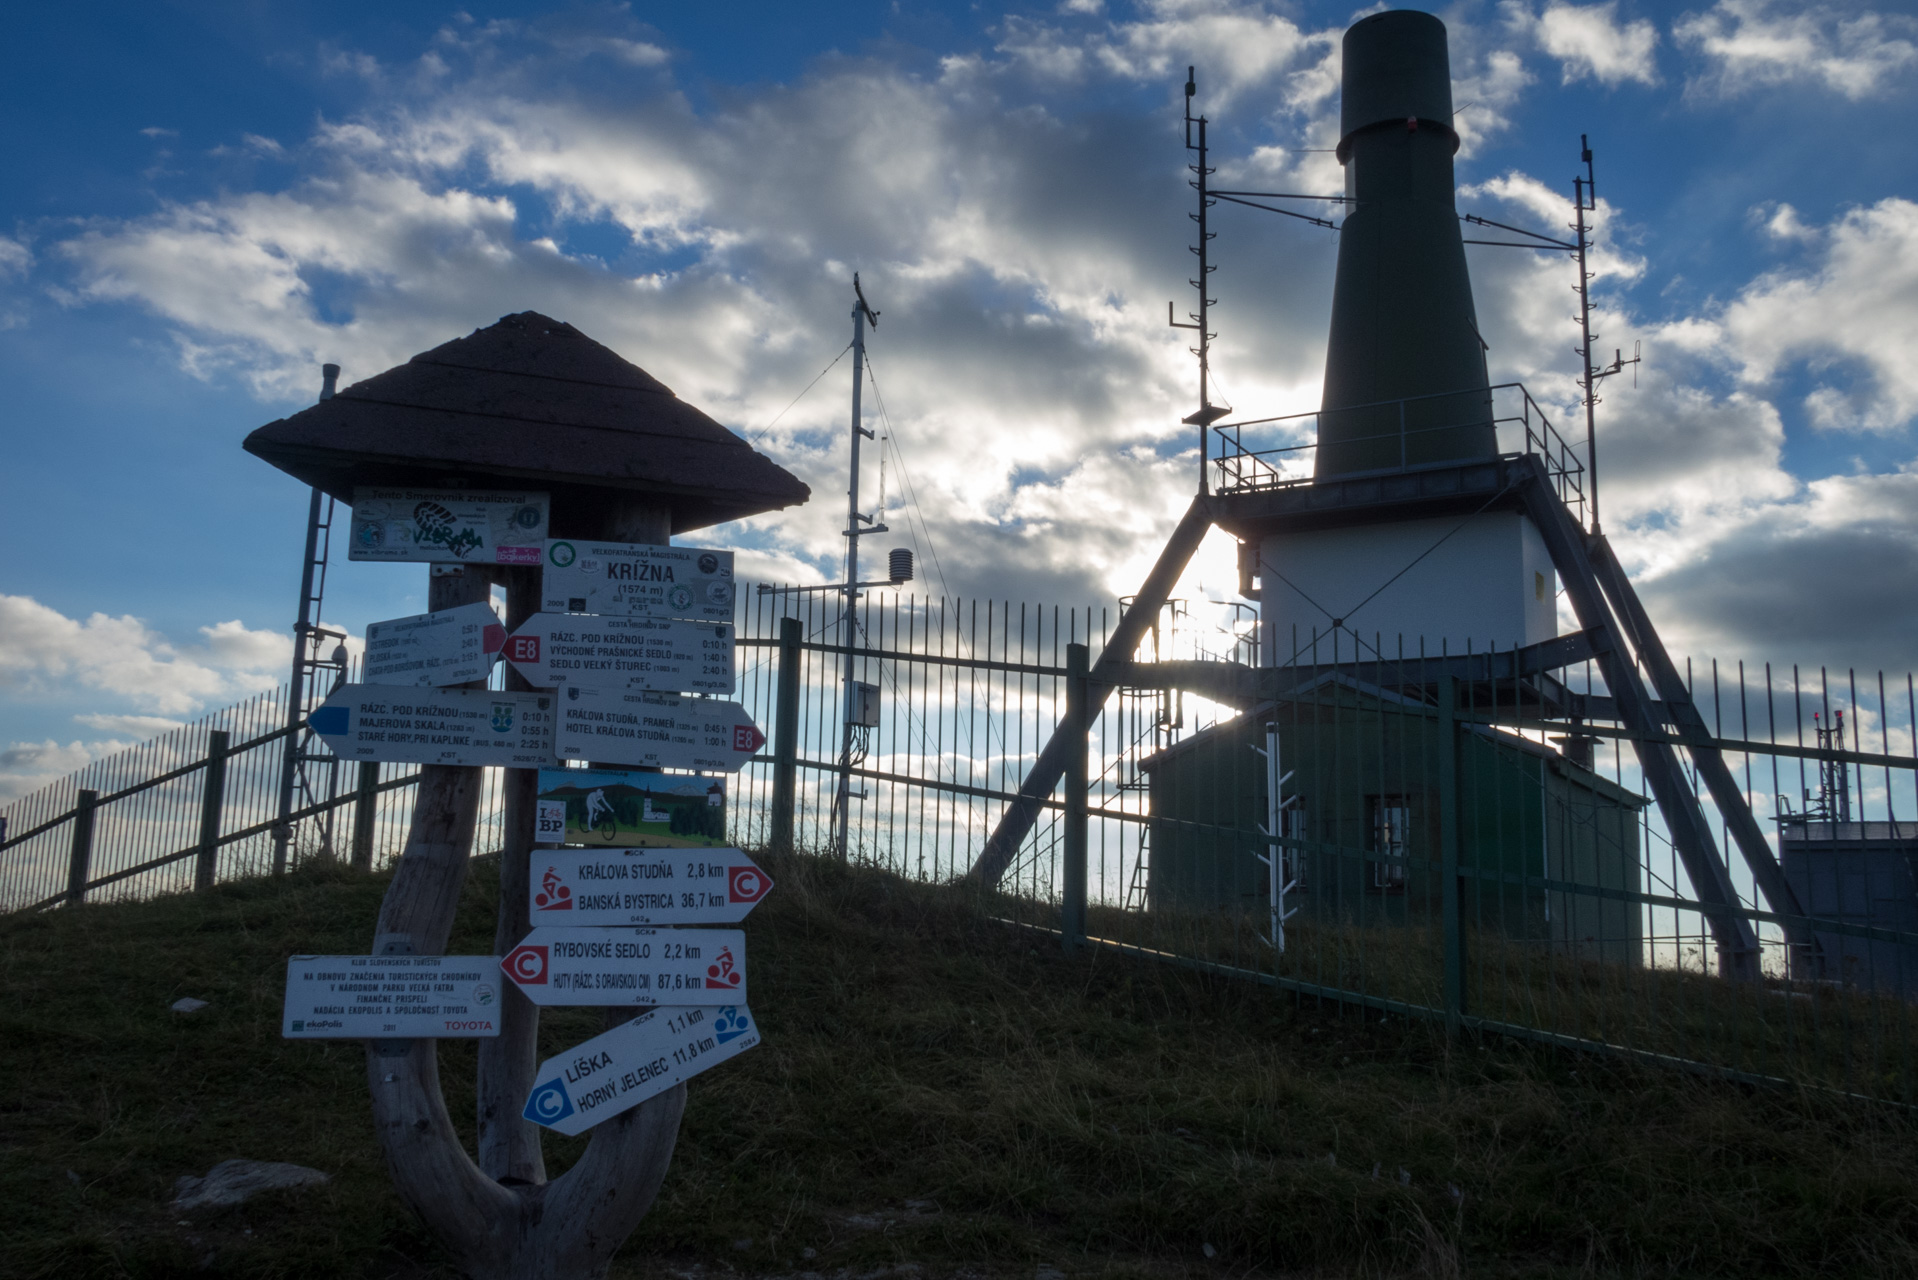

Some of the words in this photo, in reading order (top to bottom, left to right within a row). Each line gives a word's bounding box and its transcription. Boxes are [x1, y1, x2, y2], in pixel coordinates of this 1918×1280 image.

[468, 494, 526, 504] zrealizoval
[608, 560, 674, 582] KRÍŽNA
[618, 584, 646, 595] (1574
[650, 586, 664, 596] m)
[608, 620, 628, 628] CESTA
[515, 639, 537, 660] E8
[551, 631, 578, 642] RÁZC.
[582, 632, 600, 644] POD
[604, 632, 644, 645] KRÍŽNOU
[703, 640, 720, 649] 0:10
[722, 640, 727, 650] h
[550, 644, 595, 657] VÝCHODNÉ
[598, 645, 644, 658] PRAŠNICKÉ
[646, 649, 672, 660] SEDLO
[704, 652, 720, 662] 1:40
[722, 653, 727, 663] h
[550, 658, 580, 670] SEDLO
[616, 660, 652, 672] ŠTUREC
[703, 665, 720, 676] 2:40
[722, 666, 727, 676] h
[624, 694, 642, 704] CESTA
[360, 704, 389, 714] RÁZC.
[392, 706, 412, 716] POD
[416, 704, 458, 718] KRÍŽNOU
[522, 712, 541, 722] 0:10
[543, 712, 550, 722] h
[567, 708, 604, 721] KRÁĽOVA
[606, 712, 640, 726] STUDŇA,
[643, 716, 674, 728] PRAMEŇ
[704, 724, 720, 734] 0:45
[722, 724, 726, 734] h
[360, 718, 412, 730] MAJEROVA
[414, 720, 445, 730] SKALA
[522, 726, 540, 736] 0:55
[542, 726, 548, 736] h
[566, 722, 593, 734] HOTEL
[596, 726, 635, 738] KRÁĽOVA
[638, 729, 670, 742] STUDŇA
[704, 737, 720, 746] 1:00
[721, 738, 726, 747] h
[358, 730, 386, 742] STARÉ
[432, 734, 470, 746] KAPLNKE
[521, 739, 540, 750] 2:25
[542, 740, 548, 750] h
[736, 730, 753, 749] E8
[539, 820, 563, 832] BP
[579, 862, 628, 880] KRÁĽOVA
[631, 860, 674, 878] STUDŇA
[688, 863, 705, 879] 2,8
[708, 863, 724, 878] km
[579, 892, 621, 910] BANSKÁ
[624, 892, 674, 910] BYSTRICA
[681, 892, 706, 910] 36,7
[709, 892, 724, 907] km
[554, 939, 612, 958] RYBOVSKÉ
[616, 942, 650, 958] SEDLO
[664, 943, 682, 960] 2,2
[684, 944, 700, 958] km
[370, 958, 410, 966] SLOVENSKÝCH
[414, 958, 441, 966] TURISTOV
[304, 972, 314, 980] NA
[317, 972, 346, 981] OBNOVU
[350, 971, 385, 981] ZNAČENIA
[388, 970, 438, 981] TURISTICKÝCH
[441, 971, 482, 981] CHODNÍKOV
[554, 973, 572, 989] HUTY
[572, 971, 594, 992] (RÁZC.
[596, 974, 600, 989] S
[602, 974, 634, 989] ORAVSKOU
[636, 974, 650, 991] CM)
[658, 974, 682, 991] 87,6
[685, 974, 700, 989] km
[338, 982, 378, 992] NÁRODNOM
[382, 984, 405, 992] PARKU
[434, 984, 454, 992] FATRA
[356, 994, 392, 1003] FINANČNE
[396, 995, 428, 1003] PRISPELI
[314, 1005, 344, 1014] NADÁCIA
[348, 1006, 383, 1014] EKOPOLIS
[386, 1006, 390, 1014] A
[394, 1006, 440, 1014] SPOLOČNOSŤ
[443, 1006, 468, 1014] TOYOTA
[306, 1020, 342, 1028] ekoPolis
[444, 1021, 492, 1030] TOYOTA
[667, 1018, 688, 1034] 1,1
[688, 1008, 704, 1026] km
[565, 1051, 614, 1084] LÍŠKA
[576, 1080, 617, 1114] HORNÝ
[620, 1057, 670, 1093] JELENEC
[672, 1043, 699, 1066] 11,8
[698, 1036, 716, 1058] km
